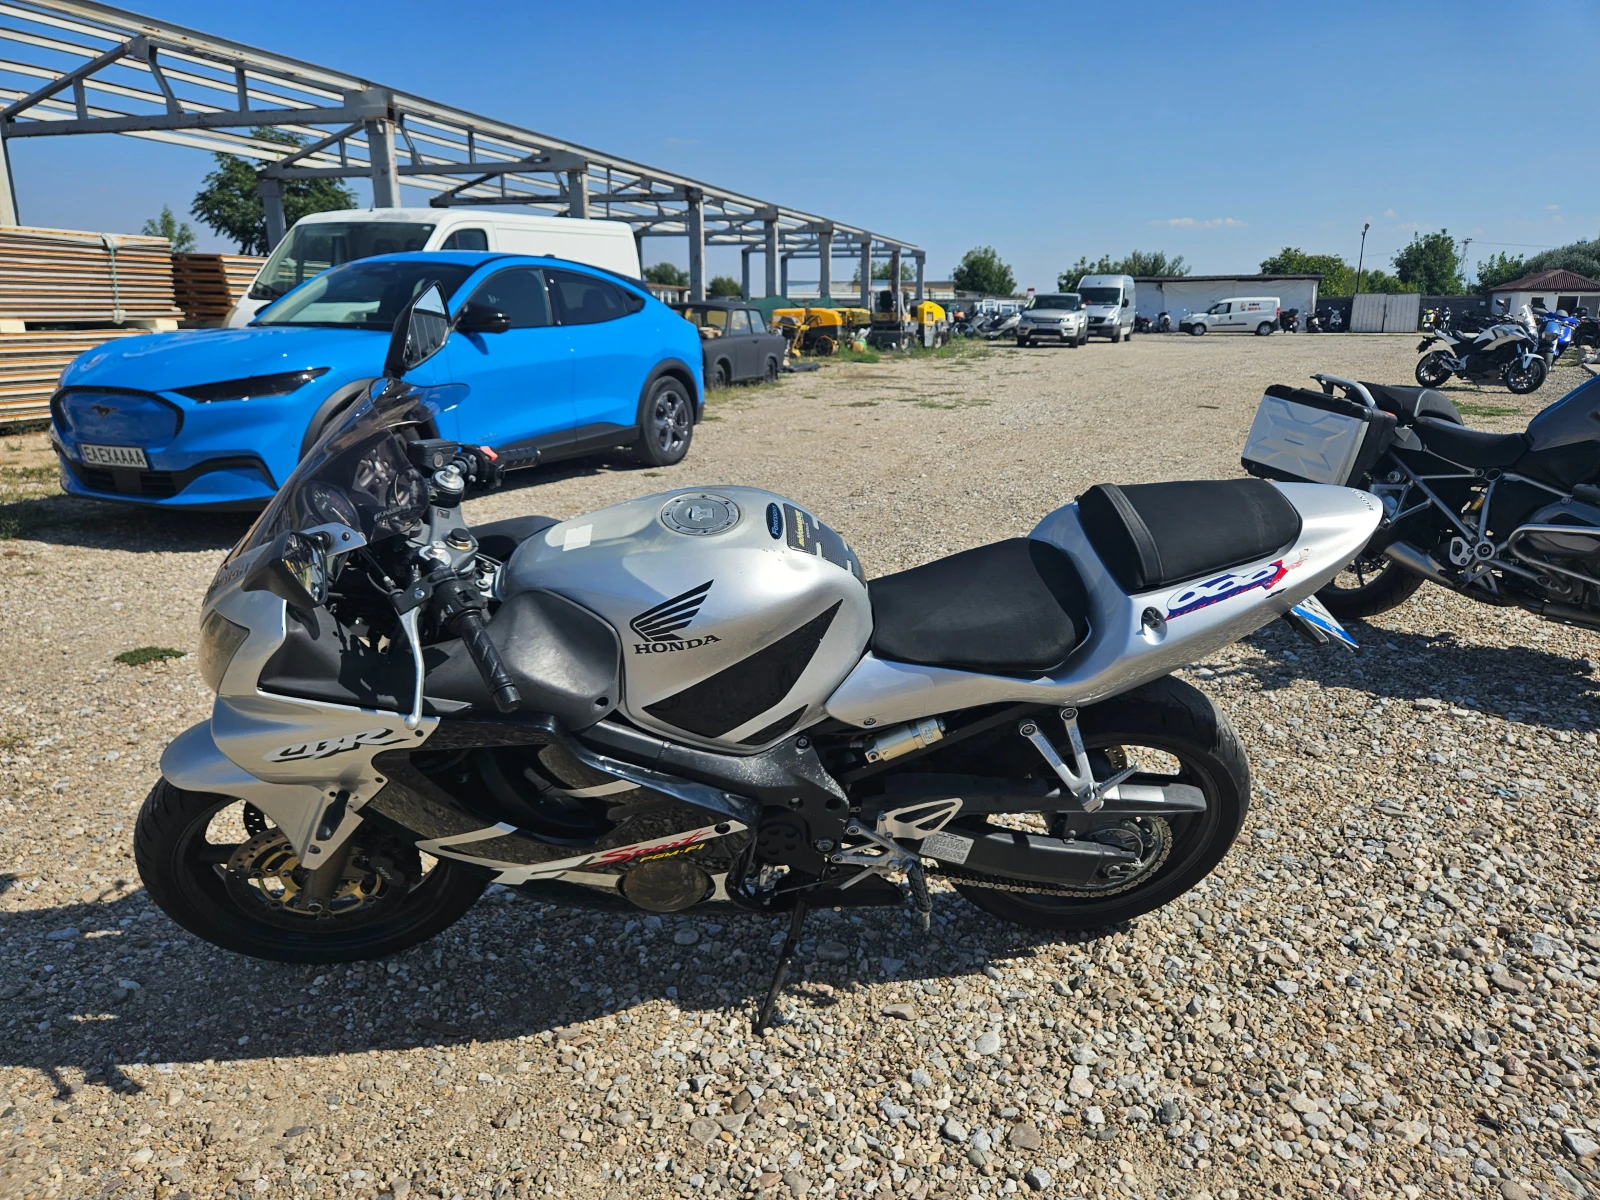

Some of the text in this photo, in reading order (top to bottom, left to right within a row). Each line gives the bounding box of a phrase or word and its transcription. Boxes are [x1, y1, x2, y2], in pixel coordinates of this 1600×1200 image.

[632, 634, 723, 655] HONDA
[262, 727, 410, 762] CBR
[584, 829, 713, 869] Sport
[639, 843, 706, 862] PGM-FI
